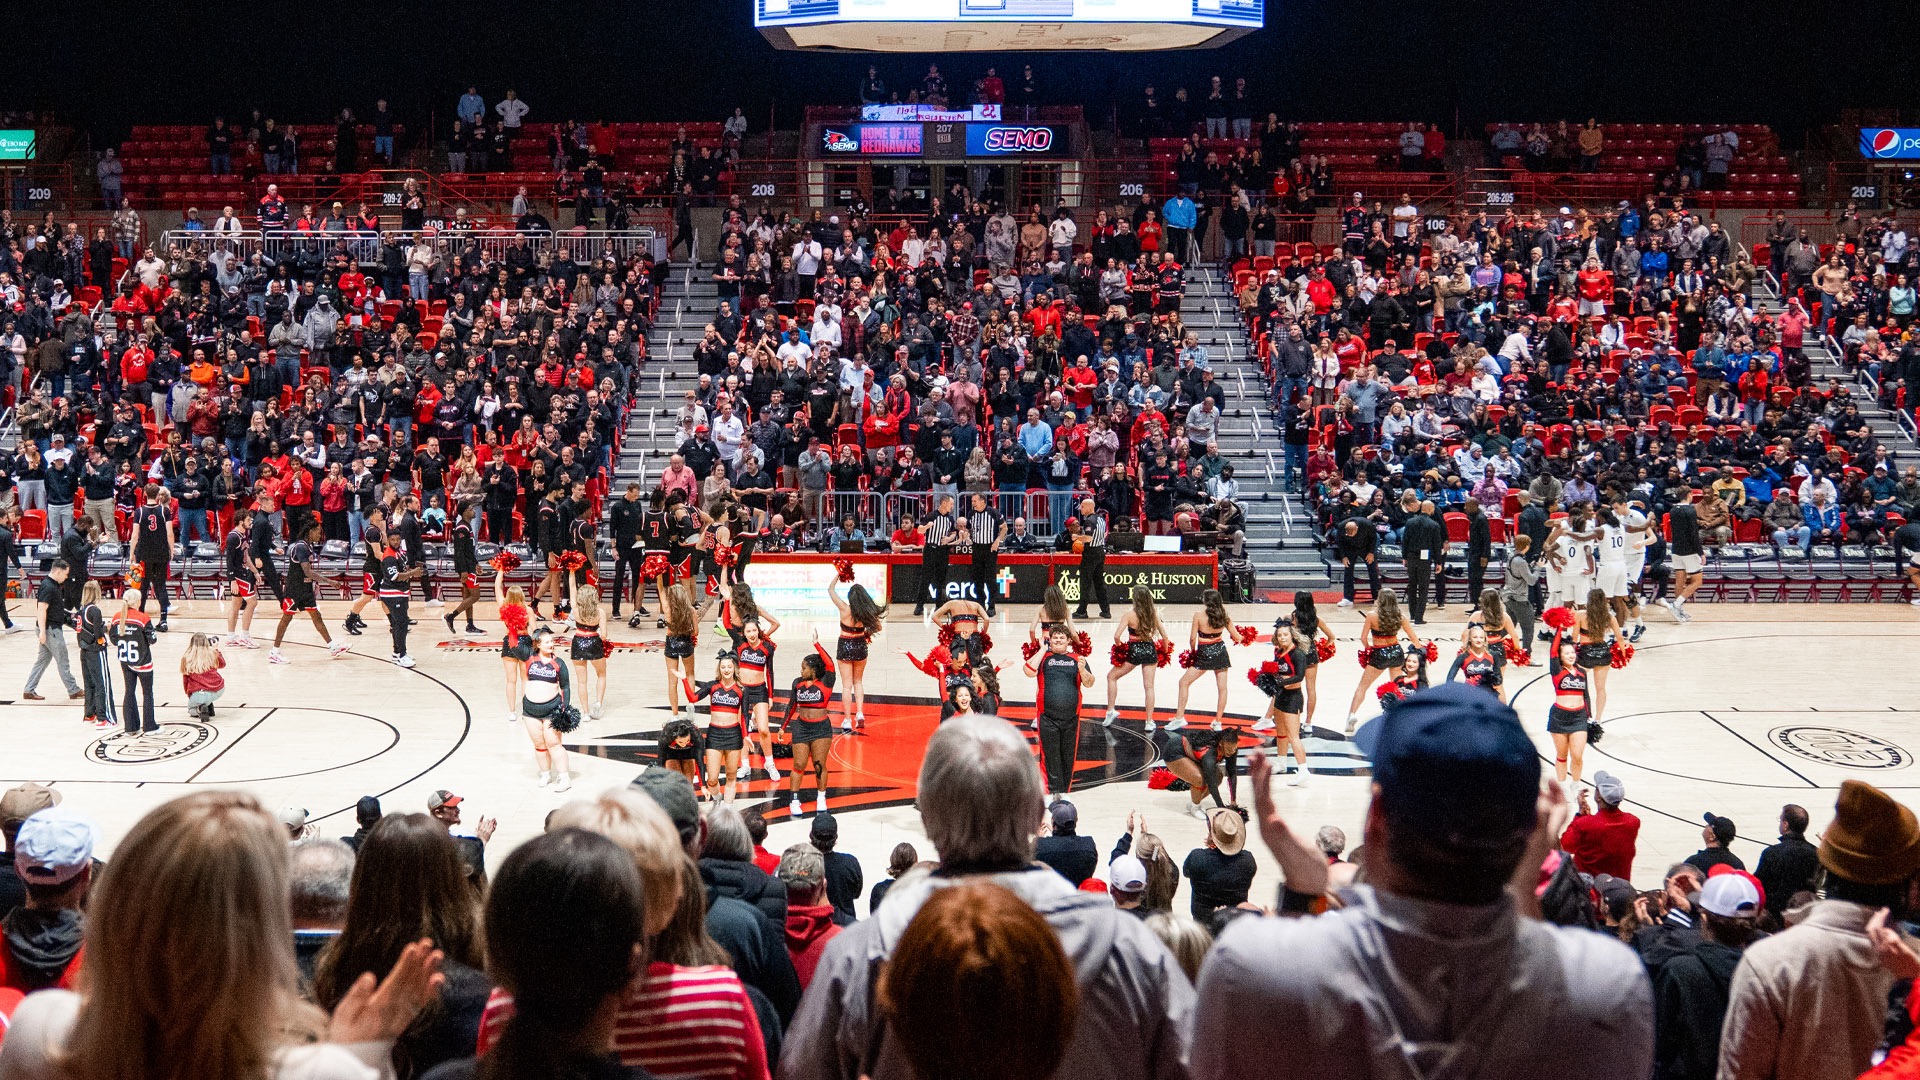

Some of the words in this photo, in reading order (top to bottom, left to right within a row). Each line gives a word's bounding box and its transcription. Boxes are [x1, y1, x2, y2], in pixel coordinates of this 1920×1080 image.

[861, 127, 887, 139] HOME
[890, 127, 902, 139] OF
[904, 127, 921, 139] THE
[937, 124, 952, 133] 207
[987, 129, 1051, 149] SEMO
[830, 141, 858, 151] SEMO
[861, 140, 921, 153] REDHAWKS
[28, 188, 51, 200] 209
[752, 184, 775, 196] 208
[1119, 184, 1143, 196] 206
[1851, 186, 1875, 198] 205
[1486, 192, 1514, 203] 206-205
[1425, 219, 1446, 230] 106
[148, 514, 157, 531] 3
[650, 521, 660, 538] 7
[704, 531, 716, 549] 55
[1611, 536, 1623, 548] 10
[1568, 546, 1576, 558] 0
[387, 566, 398, 575] 26
[1102, 572, 1132, 585] OOD
[1136, 572, 1149, 586] &
[1151, 573, 1206, 585] HUSTON
[928, 581, 990, 610] erc
[1128, 587, 1166, 600] BNK
[117, 640, 140, 662] 26
